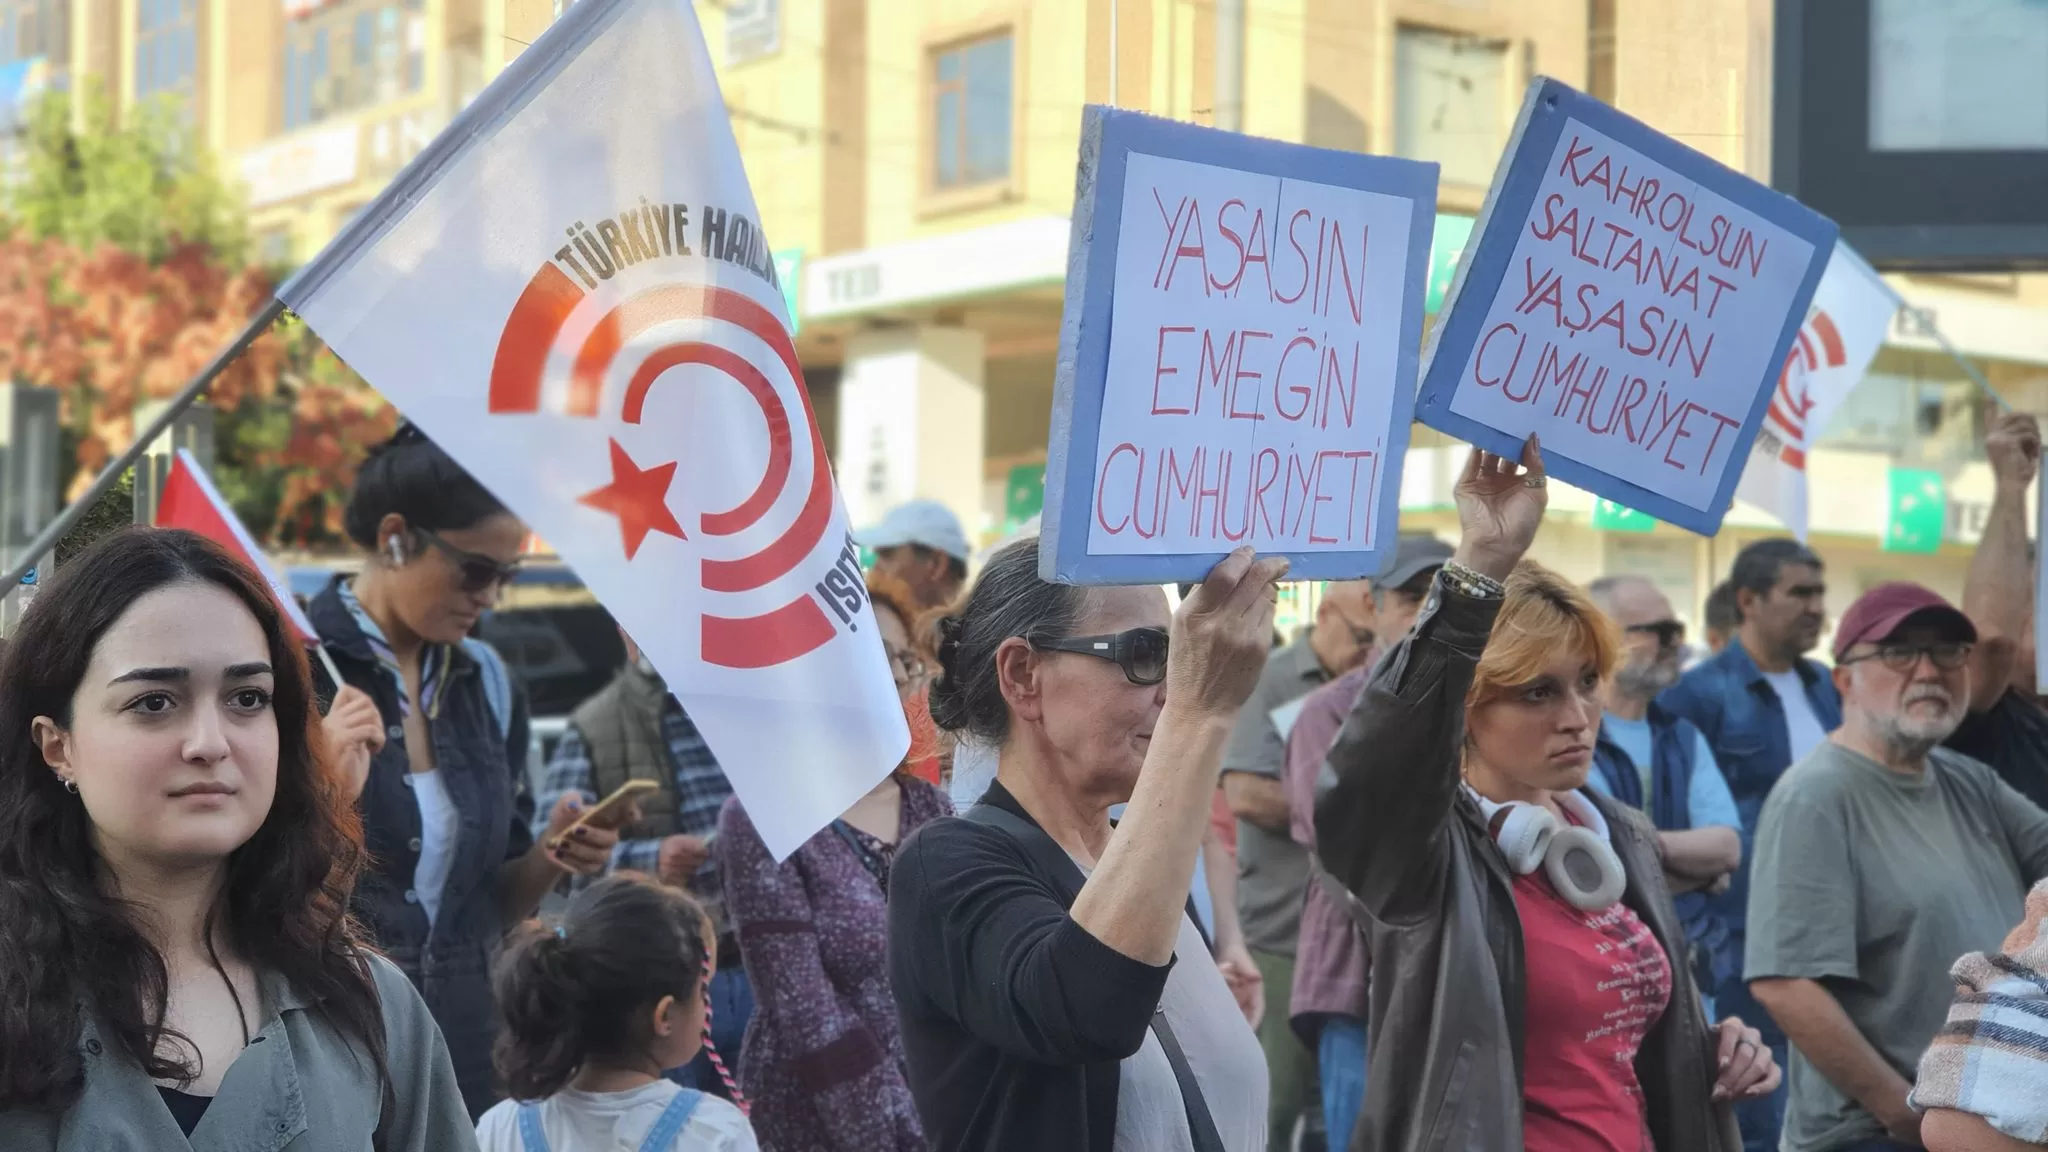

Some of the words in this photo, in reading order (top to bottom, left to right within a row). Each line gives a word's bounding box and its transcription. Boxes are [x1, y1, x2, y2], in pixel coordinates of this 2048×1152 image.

[554, 194, 693, 291] TÜRKİYE
[1152, 186, 1370, 327] YAŞASIN
[1530, 192, 1738, 319] SALTANAT
[1560, 135, 1768, 278] KAHROLSUN
[1151, 325, 1361, 432] EMEĞİN
[1515, 256, 1715, 379] YAŞASIN
[1474, 321, 1741, 477] CUMHURİYET
[1098, 434, 1382, 546] CUMHURİYETİ
